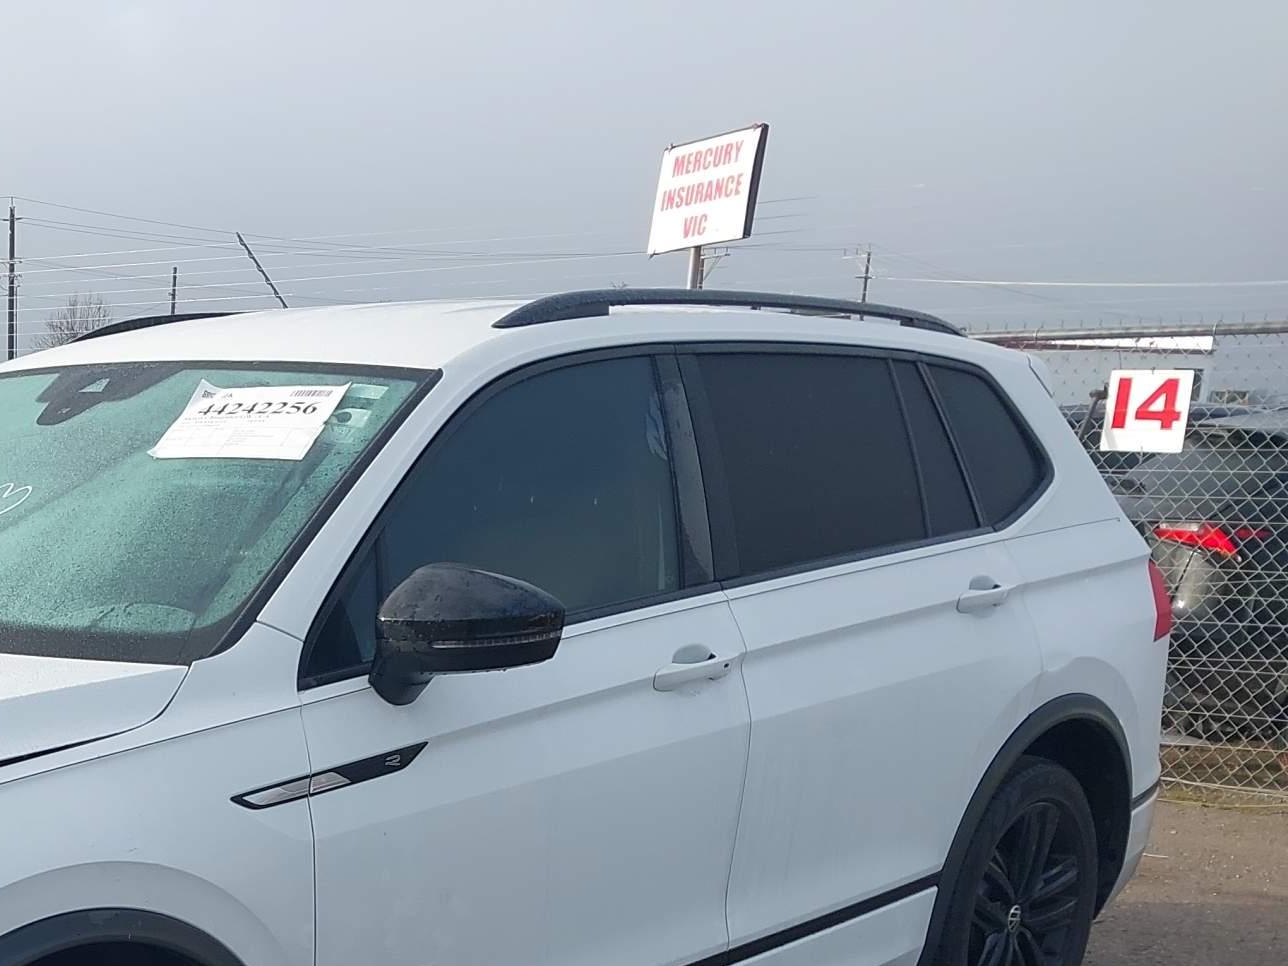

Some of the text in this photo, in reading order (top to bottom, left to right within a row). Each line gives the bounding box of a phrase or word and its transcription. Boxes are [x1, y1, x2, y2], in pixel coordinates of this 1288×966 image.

[672, 140, 745, 178] MERCURY
[660, 173, 744, 212] INSURANCE
[682, 213, 708, 239] VIC
[198, 401, 321, 416] 44242256
[1111, 377, 1181, 430] 14
